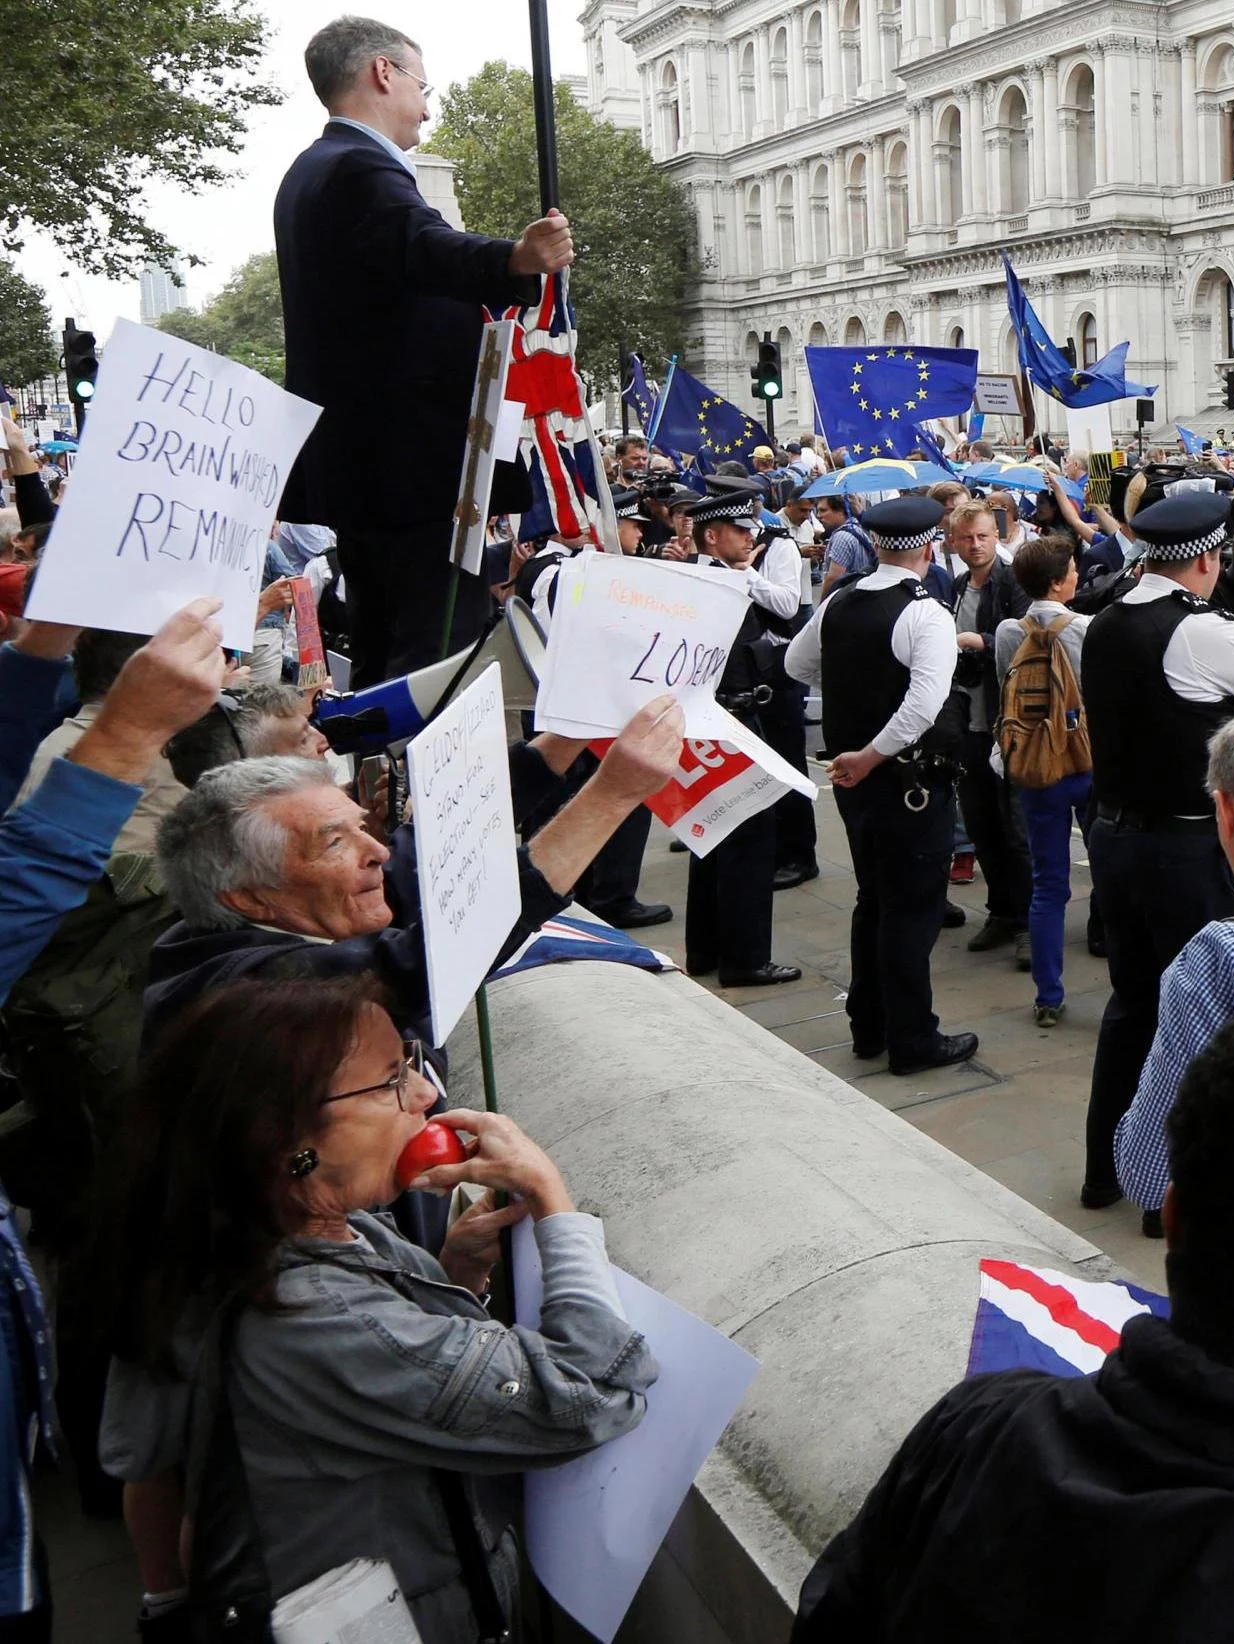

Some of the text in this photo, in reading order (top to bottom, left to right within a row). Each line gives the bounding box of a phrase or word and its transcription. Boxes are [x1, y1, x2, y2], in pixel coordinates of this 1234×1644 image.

[137, 352, 254, 431] HELLO
[703, 804, 727, 825] Vote
[753, 773, 775, 791] bac
